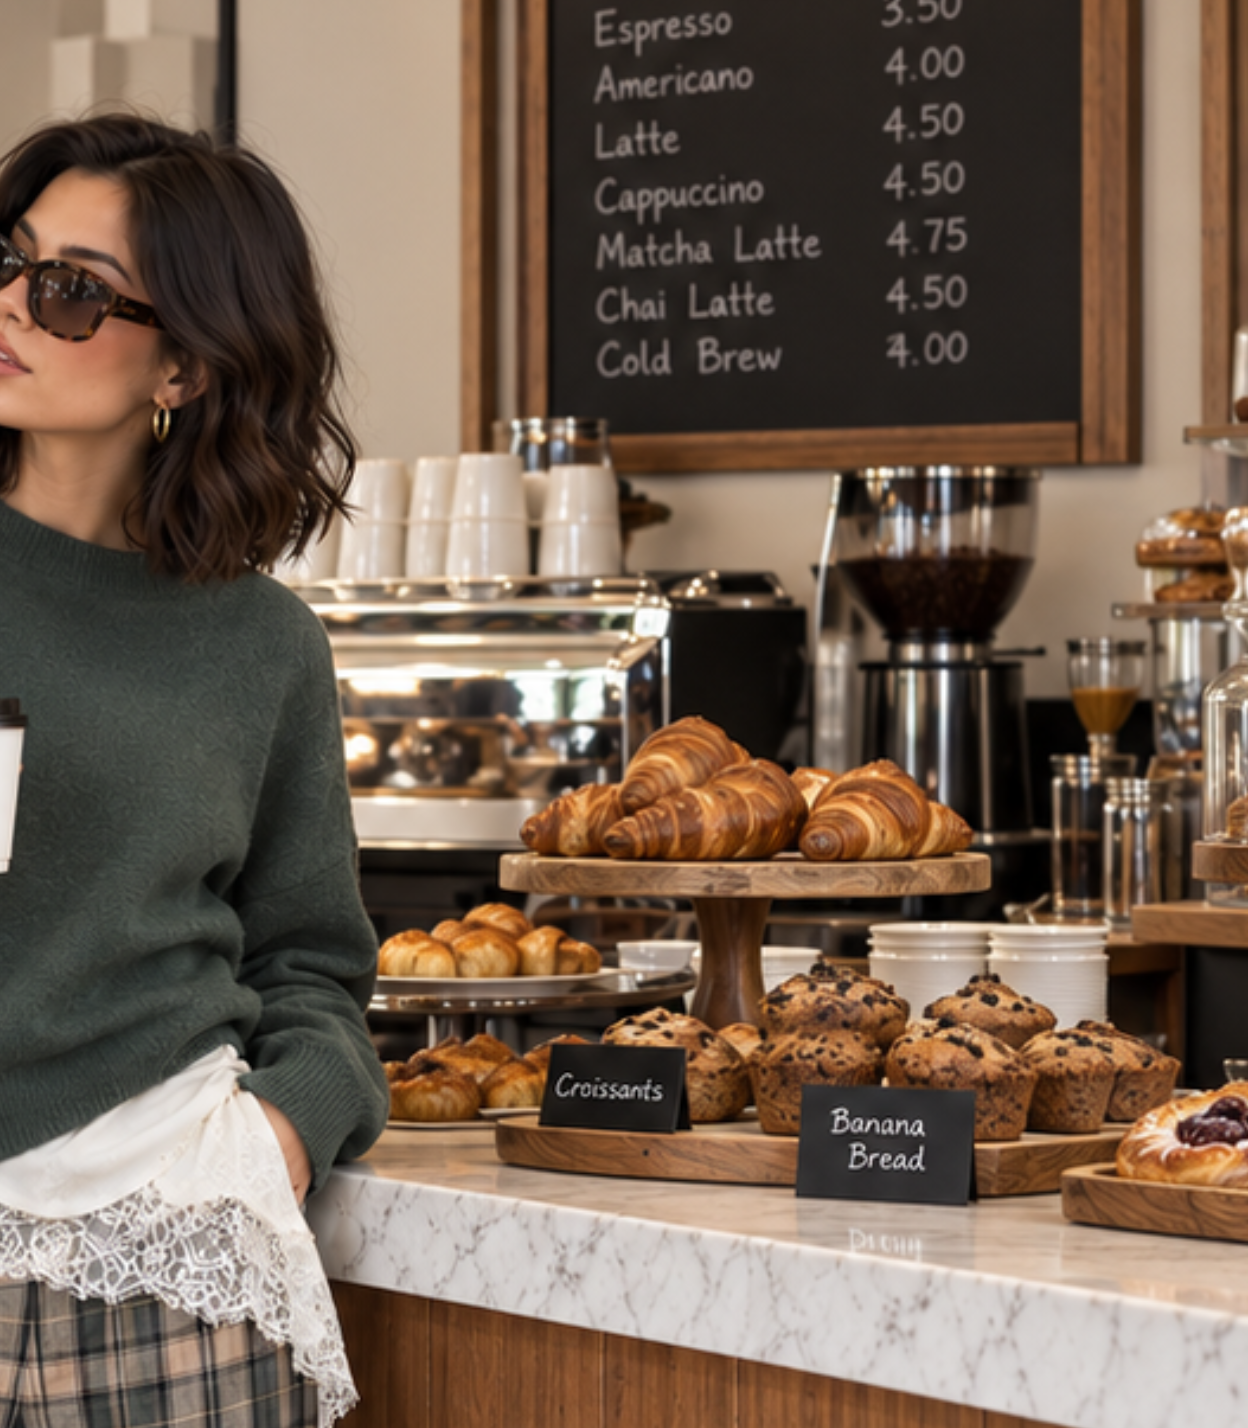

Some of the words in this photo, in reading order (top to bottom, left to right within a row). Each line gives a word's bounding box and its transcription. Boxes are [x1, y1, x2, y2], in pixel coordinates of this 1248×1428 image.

[594, 8, 733, 57] Espresso
[594, 65, 754, 103] Americano
[885, 45, 965, 85] 4.00
[595, 121, 680, 160] Latte
[882, 102, 964, 143] 4.50
[594, 176, 764, 225] Cappuccino
[883, 161, 965, 200] 4.50
[596, 230, 712, 270] Matcha
[734, 224, 821, 263] Latte
[886, 216, 968, 256] 4.75
[596, 287, 666, 324] Chai
[689, 282, 774, 319] Latte
[886, 274, 968, 313] 4.50
[597, 339, 671, 378] Cold
[697, 336, 782, 374] Brew
[556, 1072, 663, 1101] Croissants
[831, 1107, 926, 1137] Banana
[848, 1142, 926, 1171] Bread
